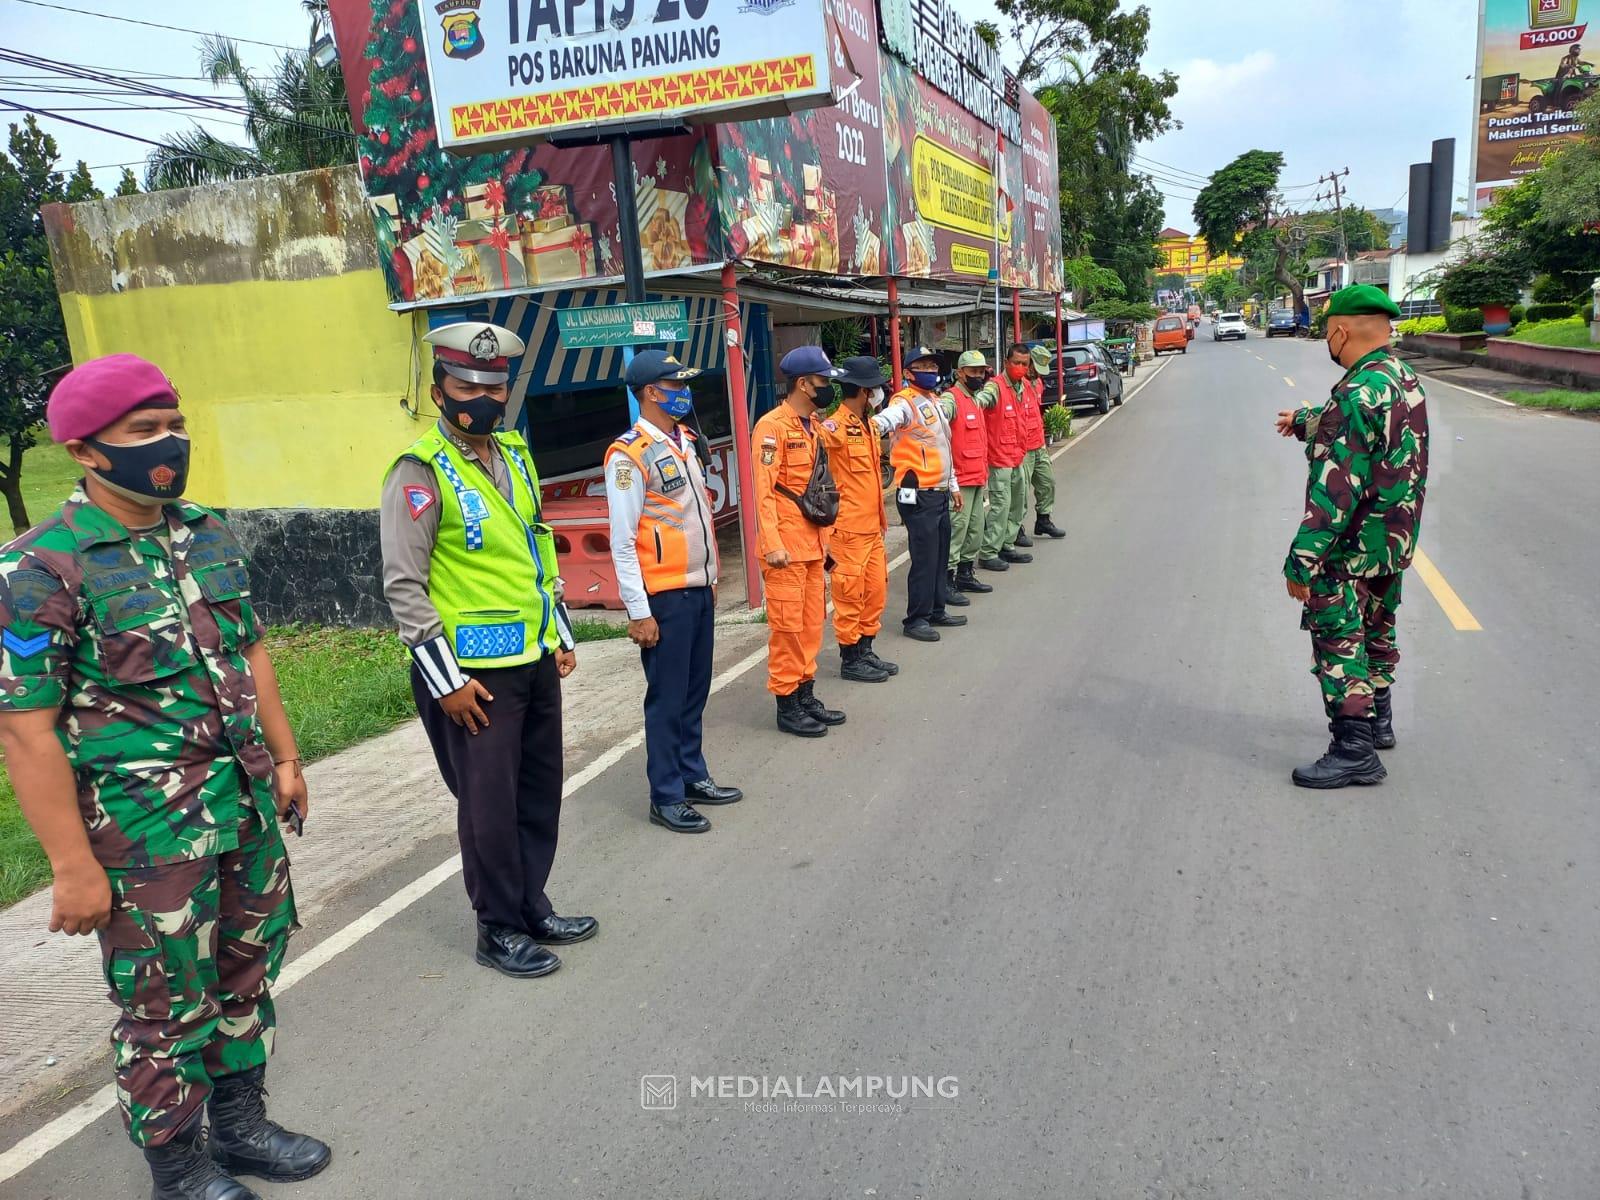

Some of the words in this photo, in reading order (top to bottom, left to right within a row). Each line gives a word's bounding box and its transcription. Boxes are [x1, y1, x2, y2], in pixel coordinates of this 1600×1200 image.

[846, 2, 869, 44] 2021
[1529, 28, 1578, 44] 14.000
[508, 52, 545, 87] POS
[550, 41, 627, 81] BARUNA
[631, 25, 721, 68] PANJANG
[834, 33, 844, 68] &
[850, 86, 879, 129] Baru
[1488, 113, 1532, 128] Puoool
[835, 121, 867, 166] 2022
[1488, 127, 1549, 141] Maksimal
[566, 311, 578, 327] JL.
[580, 307, 626, 326] LAKSAMANA
[627, 306, 643, 321] YOS
[644, 303, 681, 320] SUDARSO
